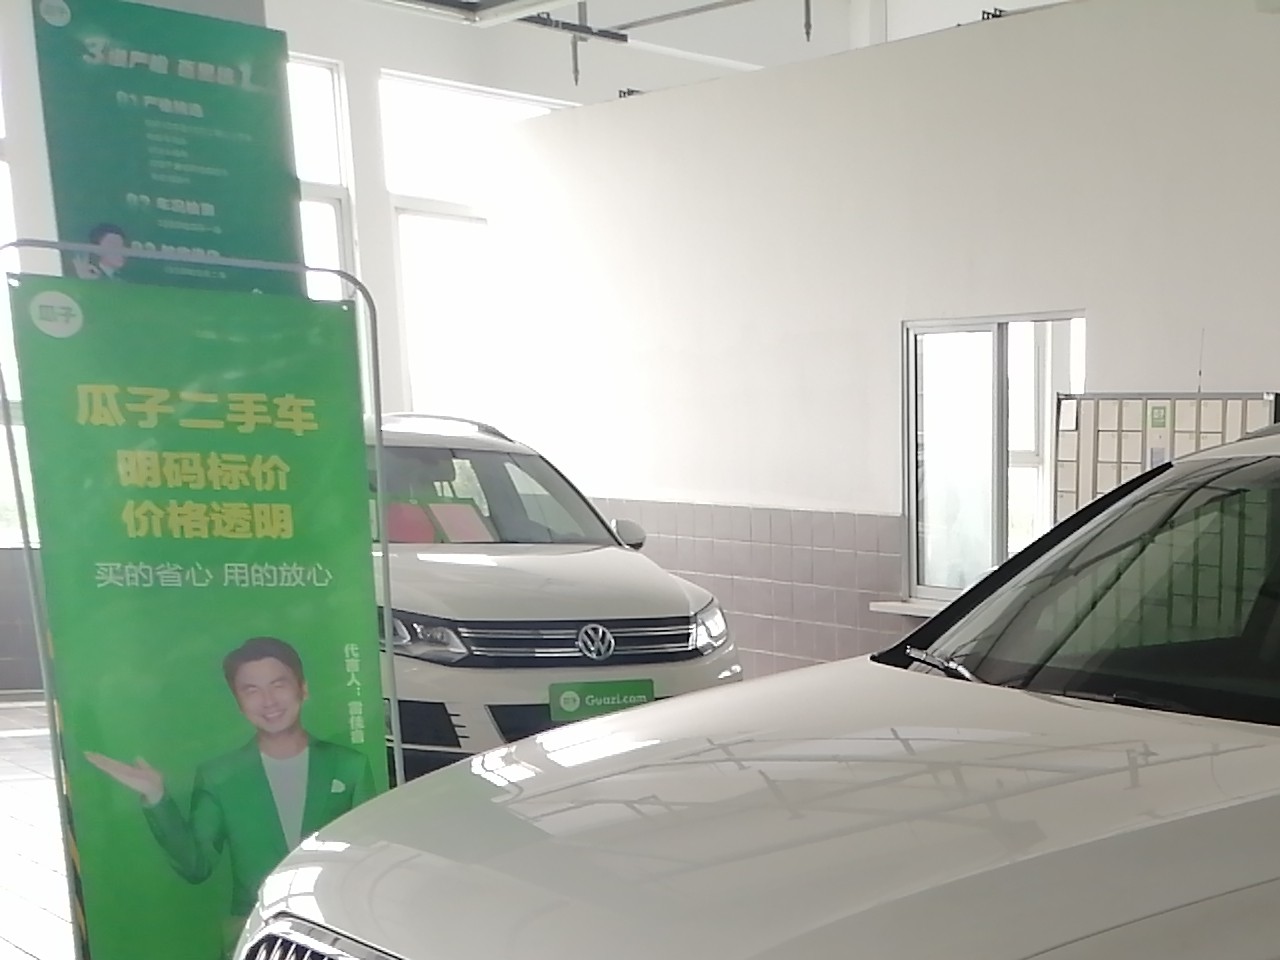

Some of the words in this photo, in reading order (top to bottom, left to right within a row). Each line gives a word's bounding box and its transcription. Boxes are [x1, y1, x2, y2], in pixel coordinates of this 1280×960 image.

[76, 384, 319, 435] 瓜子二手车
[117, 450, 290, 491] 明码标价
[121, 500, 294, 539] 价格透明
[95, 561, 214, 588] 买的省心
[223, 562, 333, 588] 用的放心
